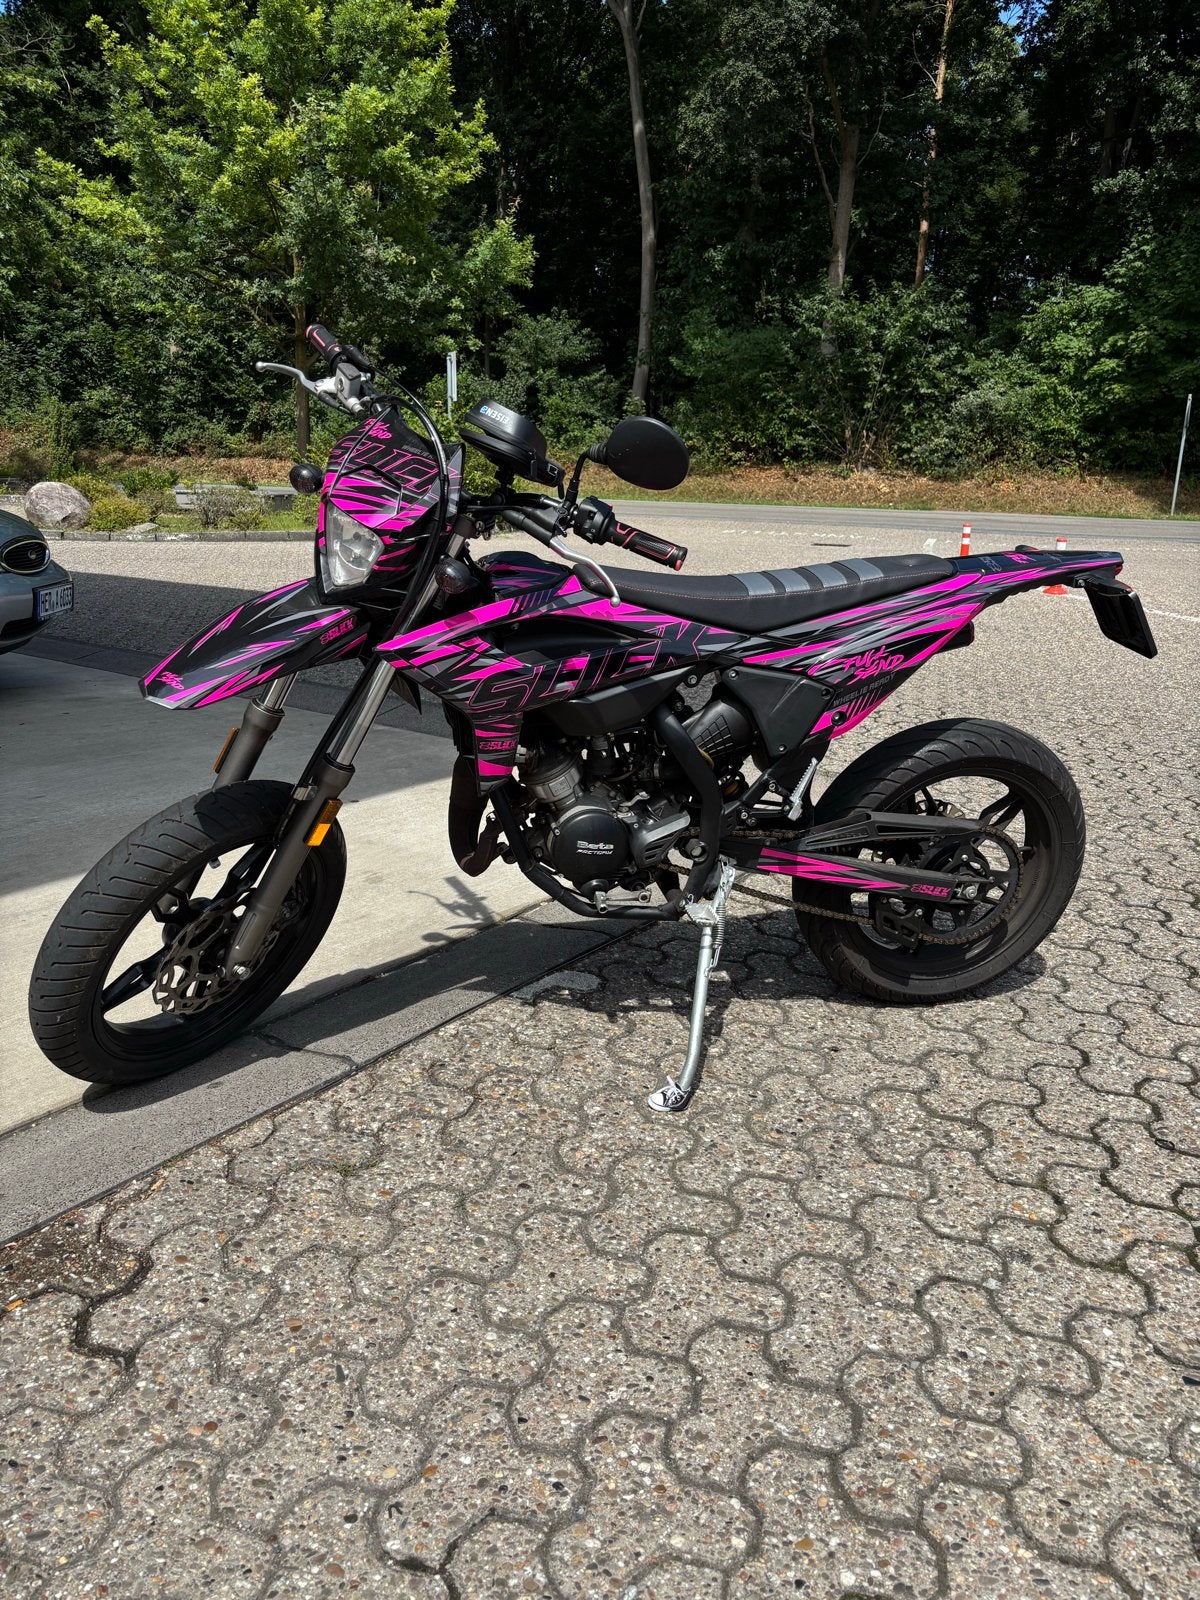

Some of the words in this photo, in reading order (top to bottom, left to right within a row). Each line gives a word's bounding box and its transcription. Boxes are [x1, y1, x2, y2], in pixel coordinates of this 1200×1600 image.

[466, 619, 706, 713] SLICK
[839, 645, 890, 673] FULL
[846, 654, 904, 685] SEND
[576, 840, 614, 850] Beta
